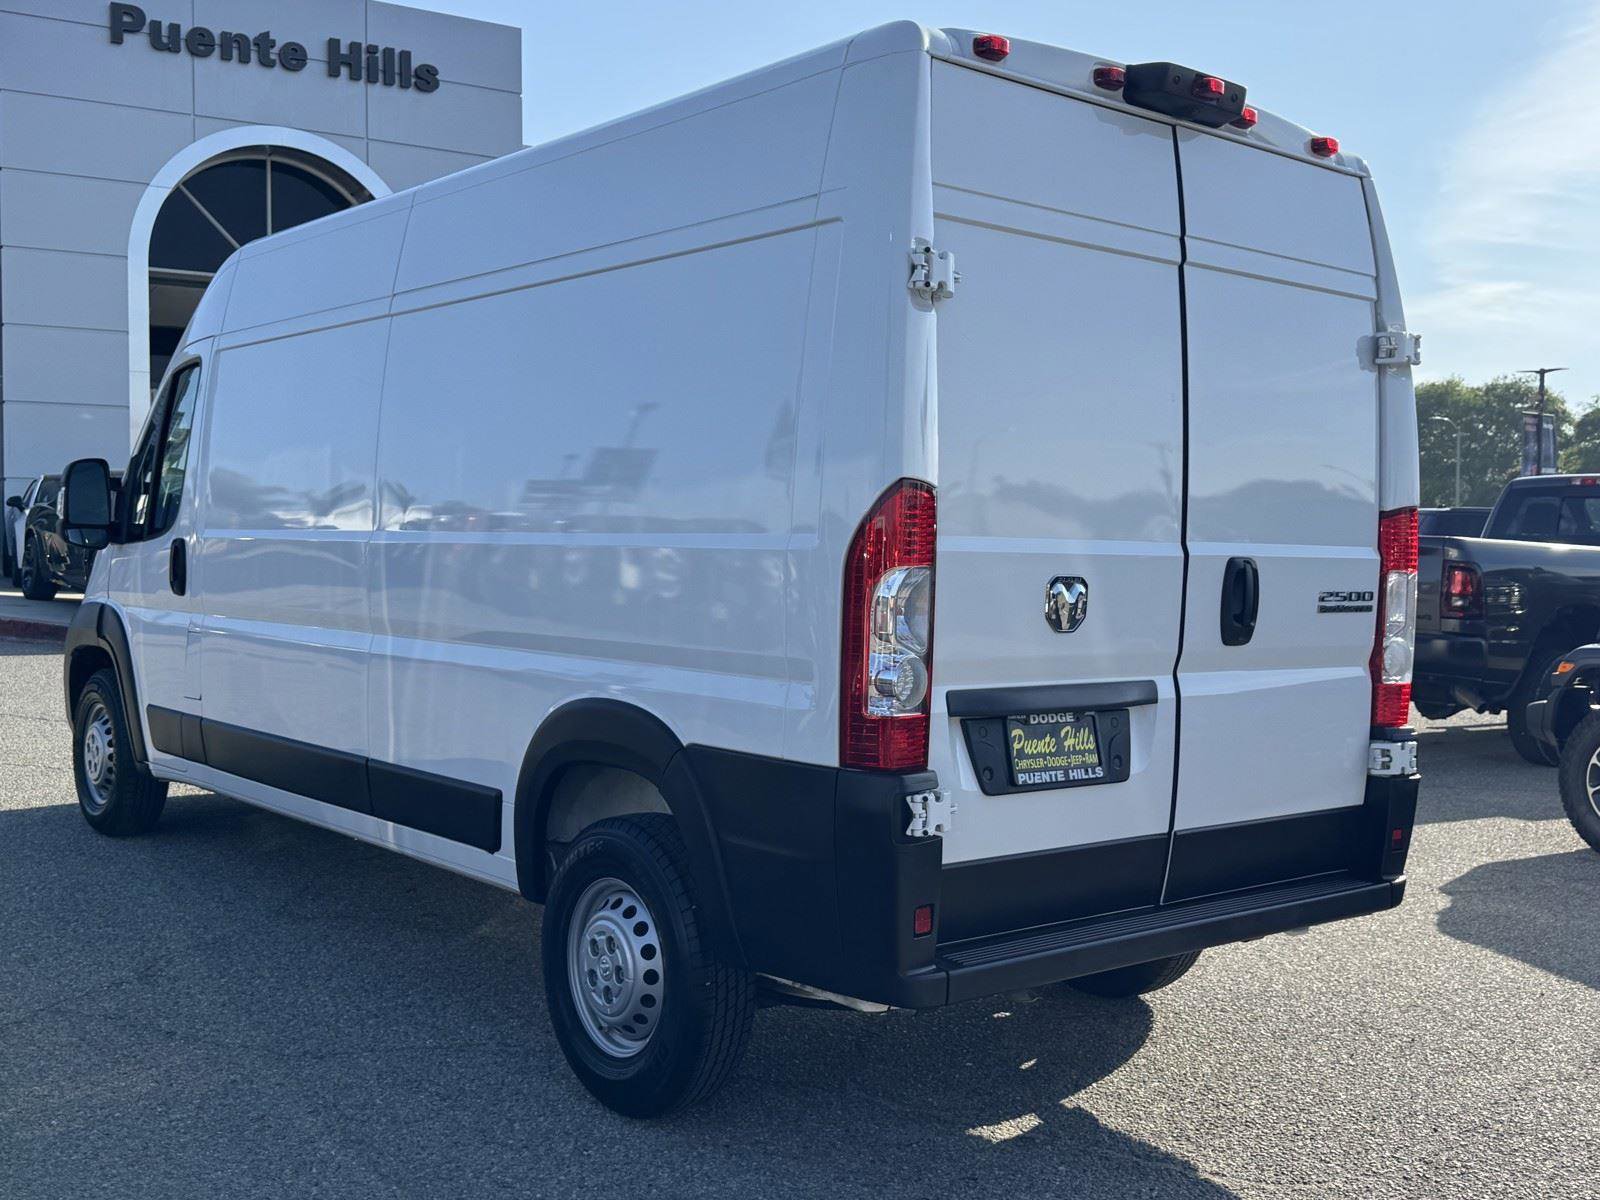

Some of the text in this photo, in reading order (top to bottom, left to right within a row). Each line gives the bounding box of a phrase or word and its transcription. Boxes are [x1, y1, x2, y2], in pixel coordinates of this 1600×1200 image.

[109, 1, 440, 93] Puente Hills
[1318, 591, 1374, 602] 2500
[1029, 712, 1075, 724] DODGE
[1011, 725, 1096, 756] Puente Hills
[1017, 766, 1104, 785] PUENTE HILLS
